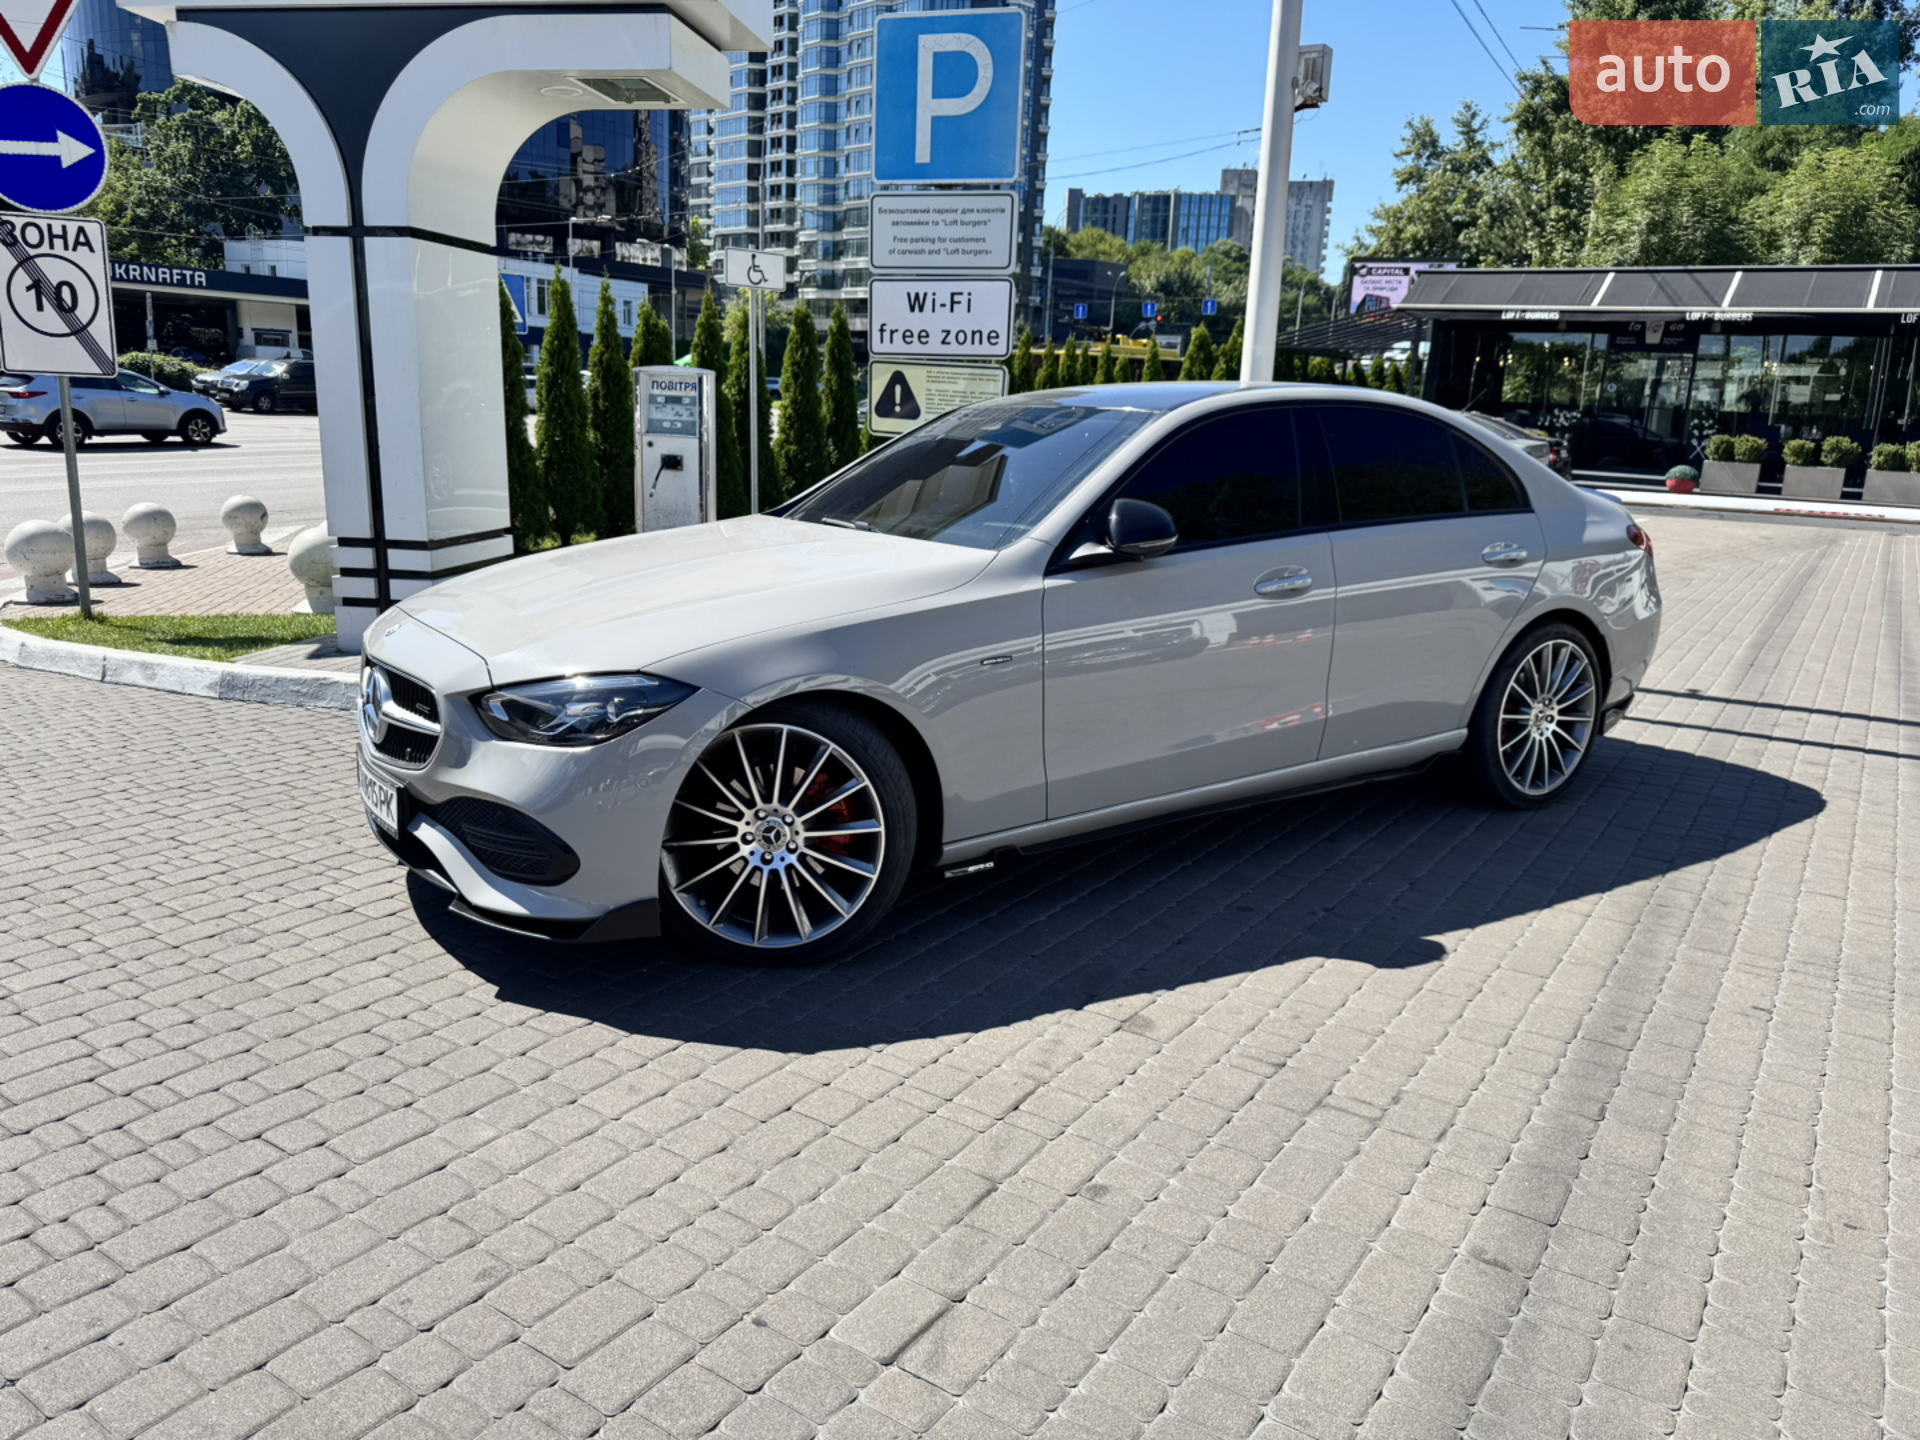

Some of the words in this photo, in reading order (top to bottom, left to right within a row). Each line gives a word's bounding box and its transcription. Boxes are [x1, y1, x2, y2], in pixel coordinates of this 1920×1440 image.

[915, 32, 994, 164] P
[878, 206, 930, 214] Безкоштовний
[932, 207, 959, 215] паркінг
[960, 207, 975, 215] для
[976, 206, 1006, 214] клієнтів
[891, 219, 930, 227] автомийки
[0, 220, 96, 254] ЗОНА
[892, 236, 908, 244] Free
[909, 235, 936, 245] parking
[937, 235, 948, 244] for
[948, 236, 986, 244] customers
[888, 248, 896, 256] of
[897, 248, 926, 256] carwash
[927, 248, 941, 256] and
[1371, 268, 1405, 276] CAPITAL
[25, 279, 79, 314] 10
[906, 291, 972, 314] Wi-Fi
[1685, 311, 1708, 321] LOFT
[878, 323, 930, 345] free
[940, 329, 1000, 346] zone
[651, 380, 697, 392] ПОВІТРЯ
